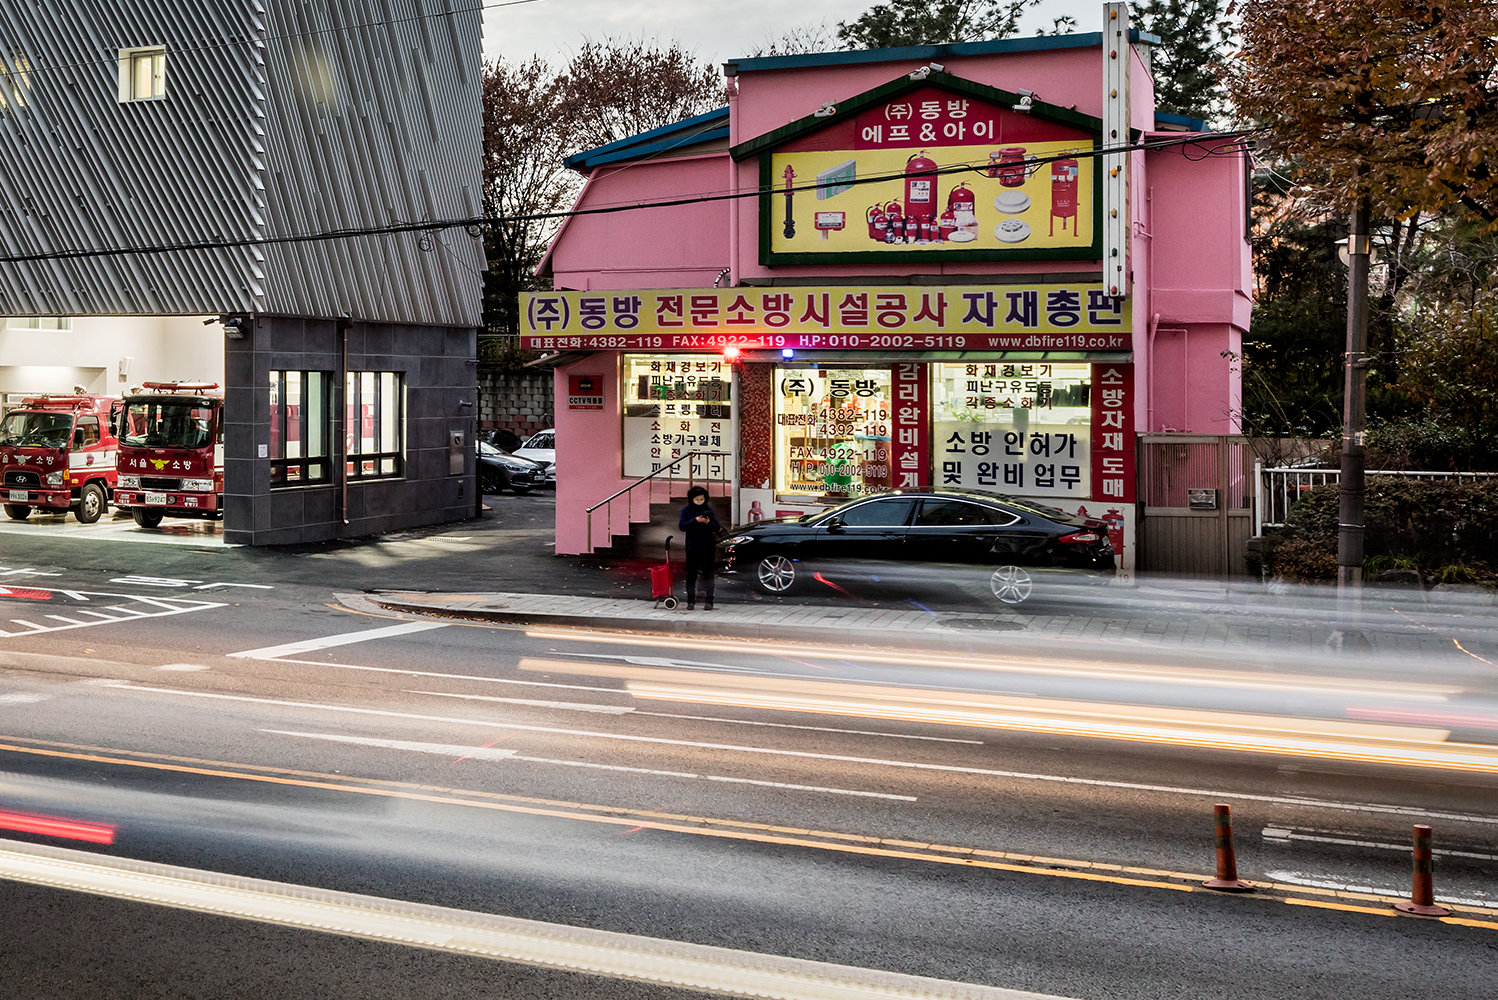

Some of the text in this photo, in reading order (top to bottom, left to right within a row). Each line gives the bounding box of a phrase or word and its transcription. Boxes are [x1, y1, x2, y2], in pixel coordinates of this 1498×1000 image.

[988, 335, 1123, 349] www.dbfire119.co.kr
[777, 408, 887, 426] 대표전화 4382-119
[819, 424, 887, 437] 4392-119
[945, 432, 1077, 458] 소방 인허가
[36, 456, 54, 466] 소방
[790, 447, 887, 461] FAX 4922-119
[129, 458, 192, 470] 서울 소방
[819, 464, 888, 478] 010-2002-5119
[942, 461, 962, 485] 및
